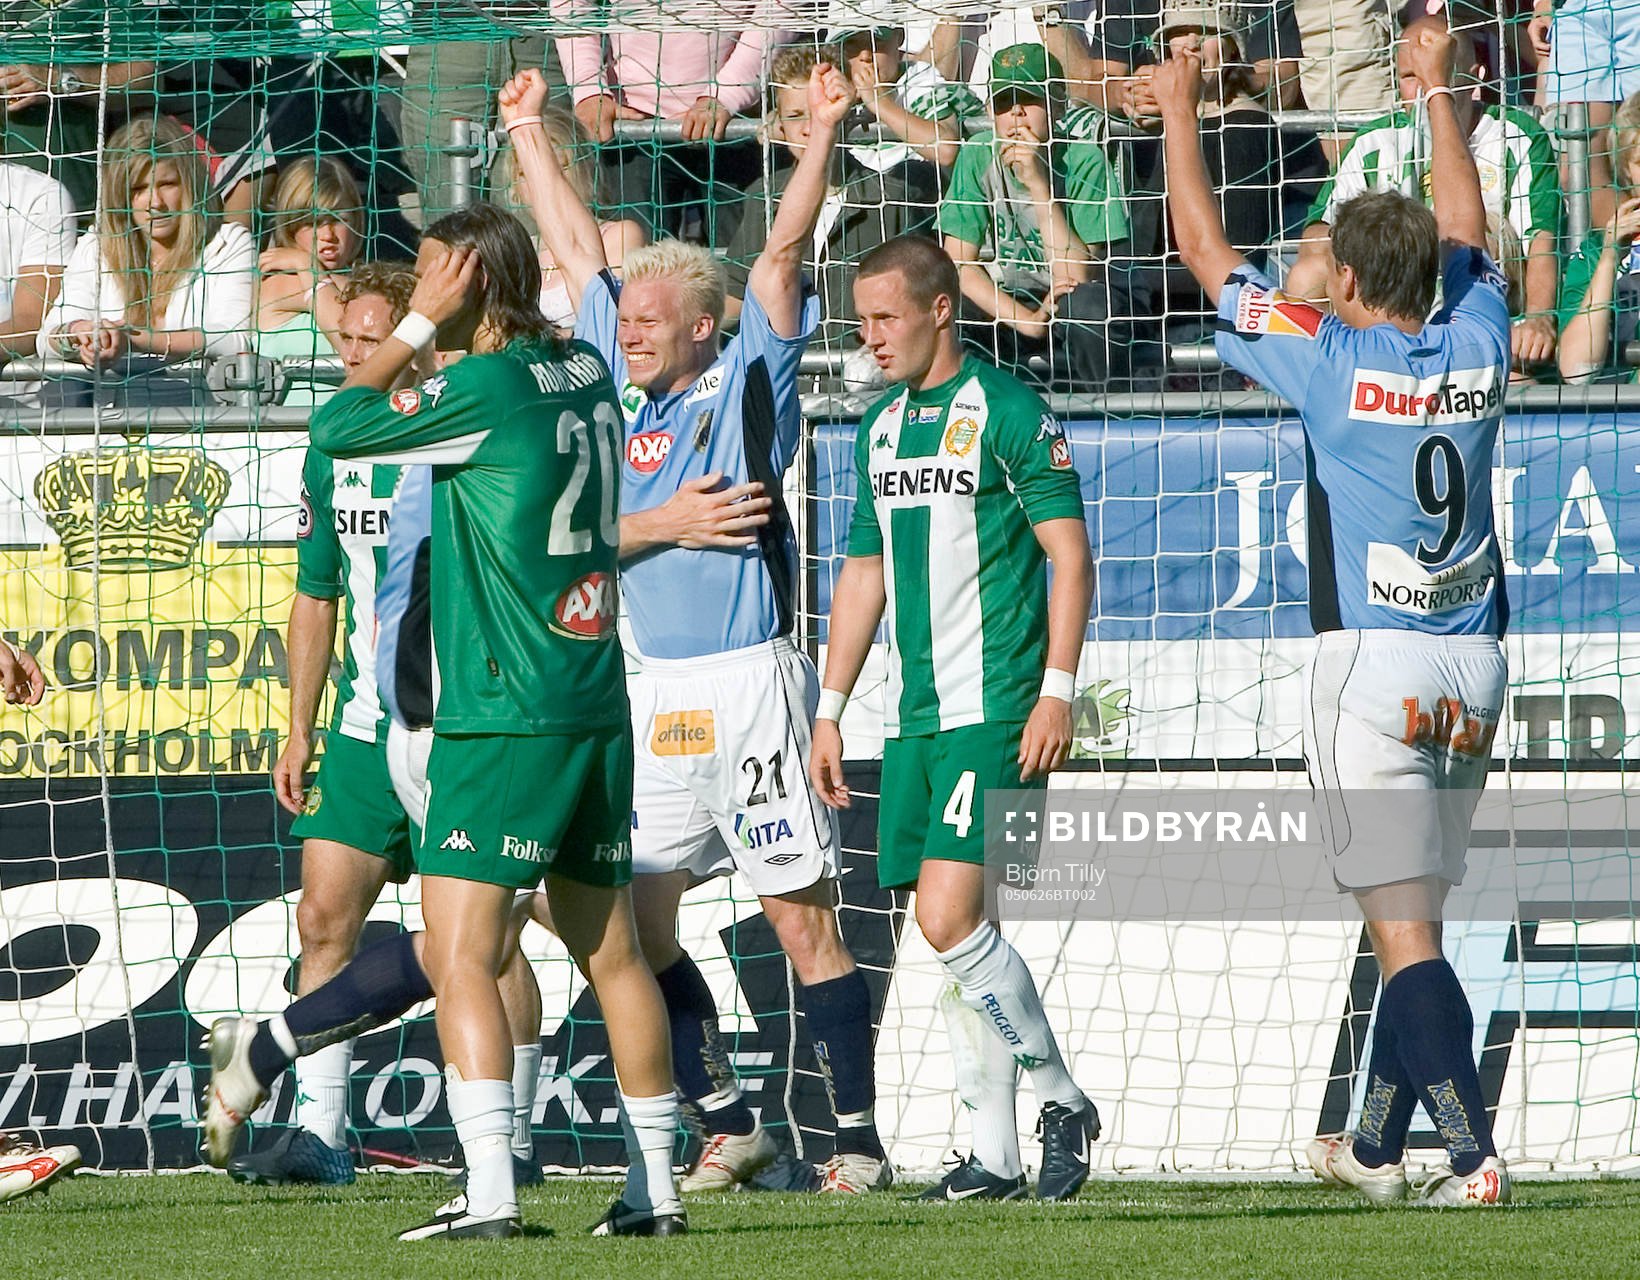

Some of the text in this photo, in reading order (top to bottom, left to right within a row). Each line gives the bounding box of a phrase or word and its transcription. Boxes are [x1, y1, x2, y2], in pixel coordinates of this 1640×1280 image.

[629, 434, 672, 464] AXA
[547, 401, 624, 556] 20
[1413, 432, 1468, 566] 9
[657, 723, 706, 744] office
[741, 749, 788, 807] 21
[942, 769, 977, 838] 4
[747, 818, 794, 849] SITA
[981, 992, 1024, 1047] PEUGEOT
